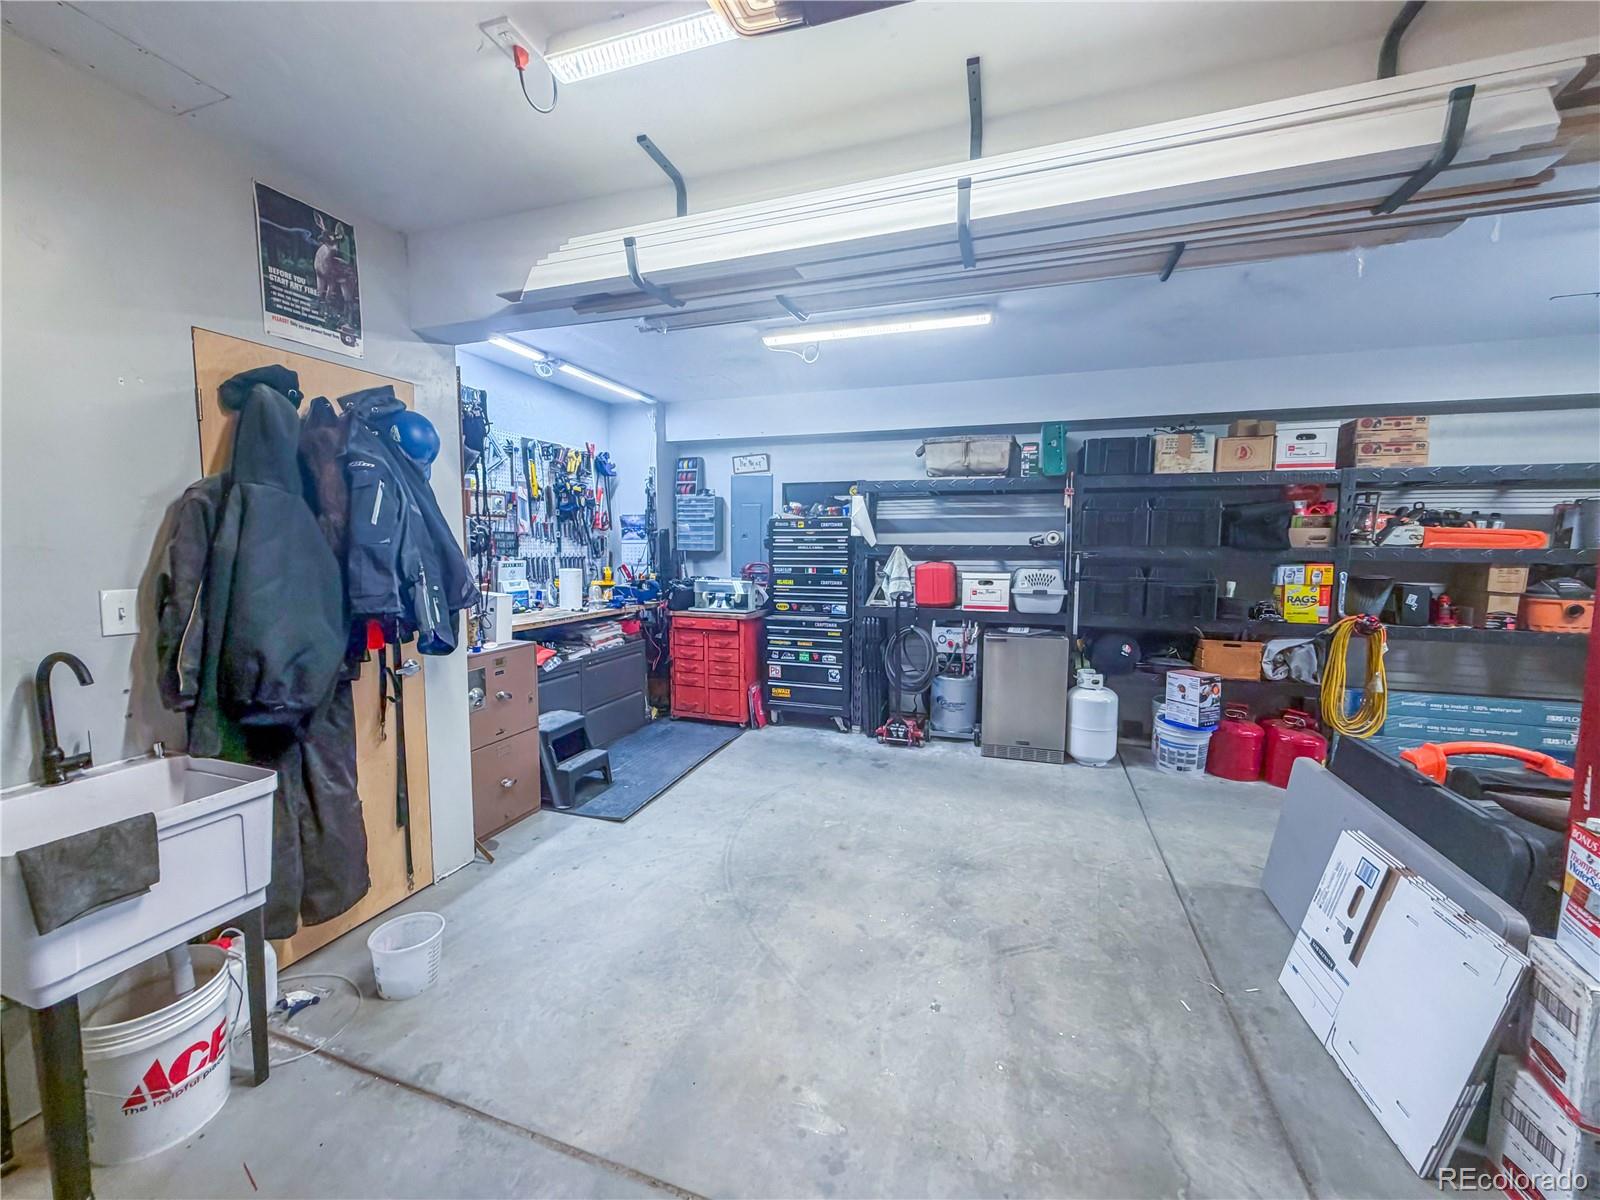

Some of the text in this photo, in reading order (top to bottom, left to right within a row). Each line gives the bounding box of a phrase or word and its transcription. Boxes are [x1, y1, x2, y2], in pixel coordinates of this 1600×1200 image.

[268, 265, 306, 284] BEFORE YOU
[269, 274, 289, 286] START
[290, 281, 303, 291] ANY
[1287, 595, 1317, 603] RAGS
[1571, 828, 1599, 852] BONUS
[121, 1015, 227, 1109] ACE
[122, 1105, 148, 1117] The
[152, 1074, 202, 1107] helpful
